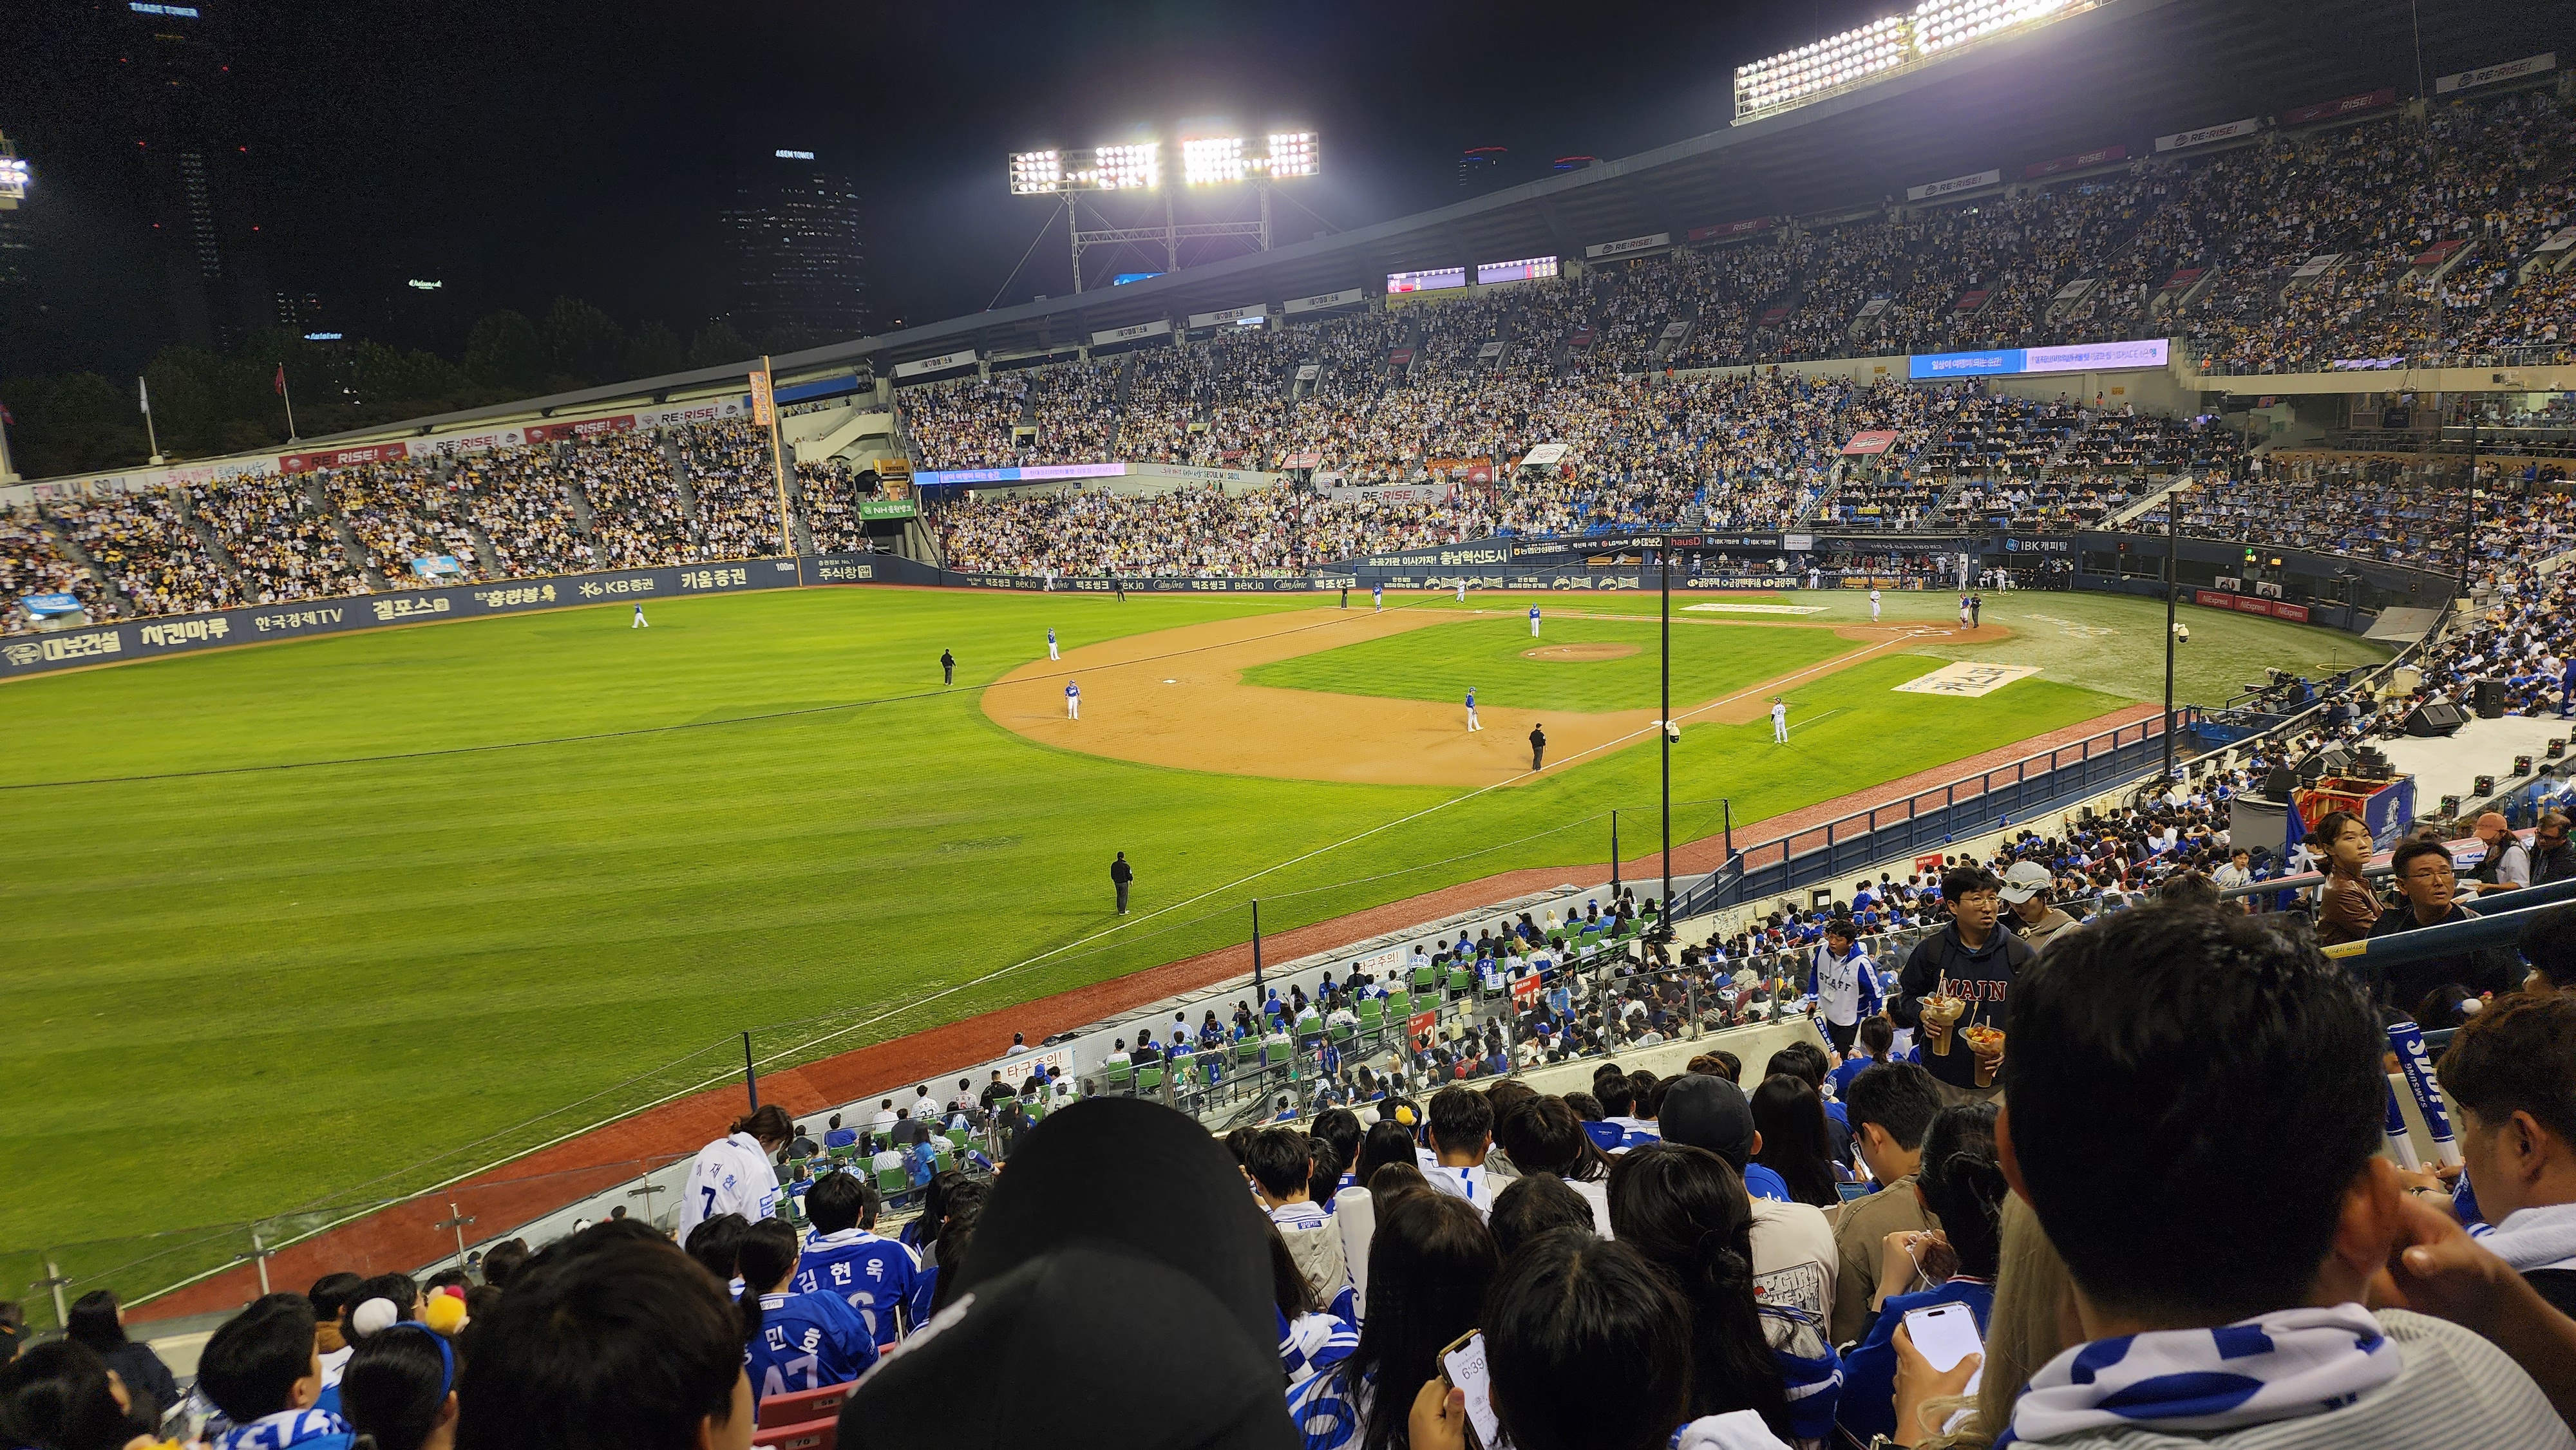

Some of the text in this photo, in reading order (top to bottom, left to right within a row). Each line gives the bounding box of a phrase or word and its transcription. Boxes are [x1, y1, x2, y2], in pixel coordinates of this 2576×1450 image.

[2190, 126, 2238, 142] RE:RISE!
[2078, 151, 2105, 165] RISE!
[1940, 176, 1982, 191] RE:RISE!
[1733, 221, 1756, 232] RISE!
[1615, 238, 1653, 250] RE:RISE!
[661, 406, 718, 423] RE:RISE!
[436, 435, 498, 449] RE:RISE!
[1361, 489, 1417, 501] RE:RISE!
[1368, 549, 1507, 566] 공공기관 이사가자! 충남혁신도시
[775, 562, 795, 571] 100m
[681, 568, 747, 589] 키움증권
[1075, 581, 1109, 590] 백조씽크
[1191, 580, 1227, 590] 백조씽크
[2202, 595, 2228, 606] AliExpress
[2240, 601, 2266, 612] AliExpress
[254, 608, 344, 632] 한국경제TV
[2278, 607, 2303, 618] AliExpress
[140, 617, 230, 646] 치킨마루
[1481, 966, 1493, 976] 39
[1819, 972, 1852, 992] STAFF
[1942, 977, 2007, 1001] MAIN
[2404, 1062, 2428, 1109] SAMSUNG
[701, 1185, 716, 1220] 7
[797, 1258, 884, 1294] 김현욱
[1461, 1357, 1485, 1380] 6:39
